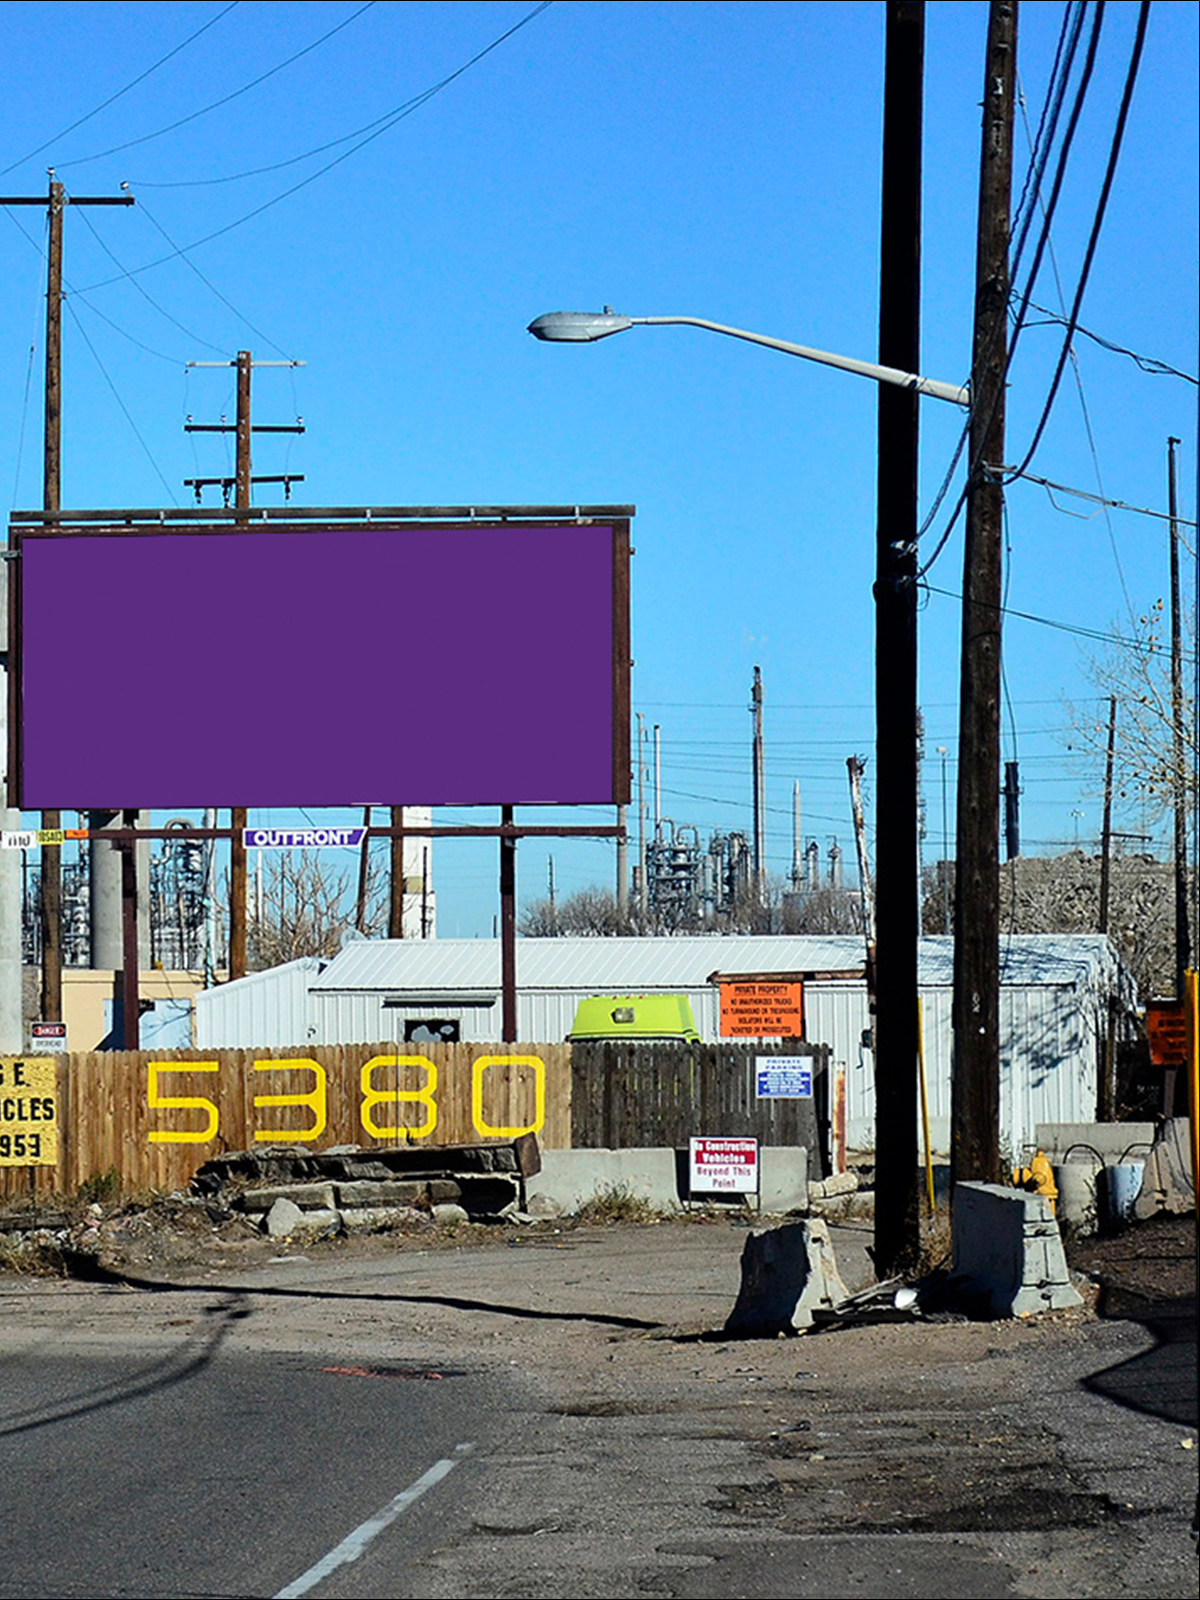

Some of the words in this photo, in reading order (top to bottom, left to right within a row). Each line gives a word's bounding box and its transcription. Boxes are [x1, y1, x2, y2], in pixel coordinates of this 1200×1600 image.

[254, 830, 353, 846] OUTFRONT
[734, 985, 756, 994] PRIVATE
[758, 985, 788, 994] PROPERTY
[147, 1055, 546, 1142] 5380
[705, 1140, 756, 1151] Construction
[702, 1152, 746, 1163] Vehicles
[697, 1166, 729, 1176] Beyond
[733, 1166, 751, 1176] This
[712, 1178, 736, 1188] Point
